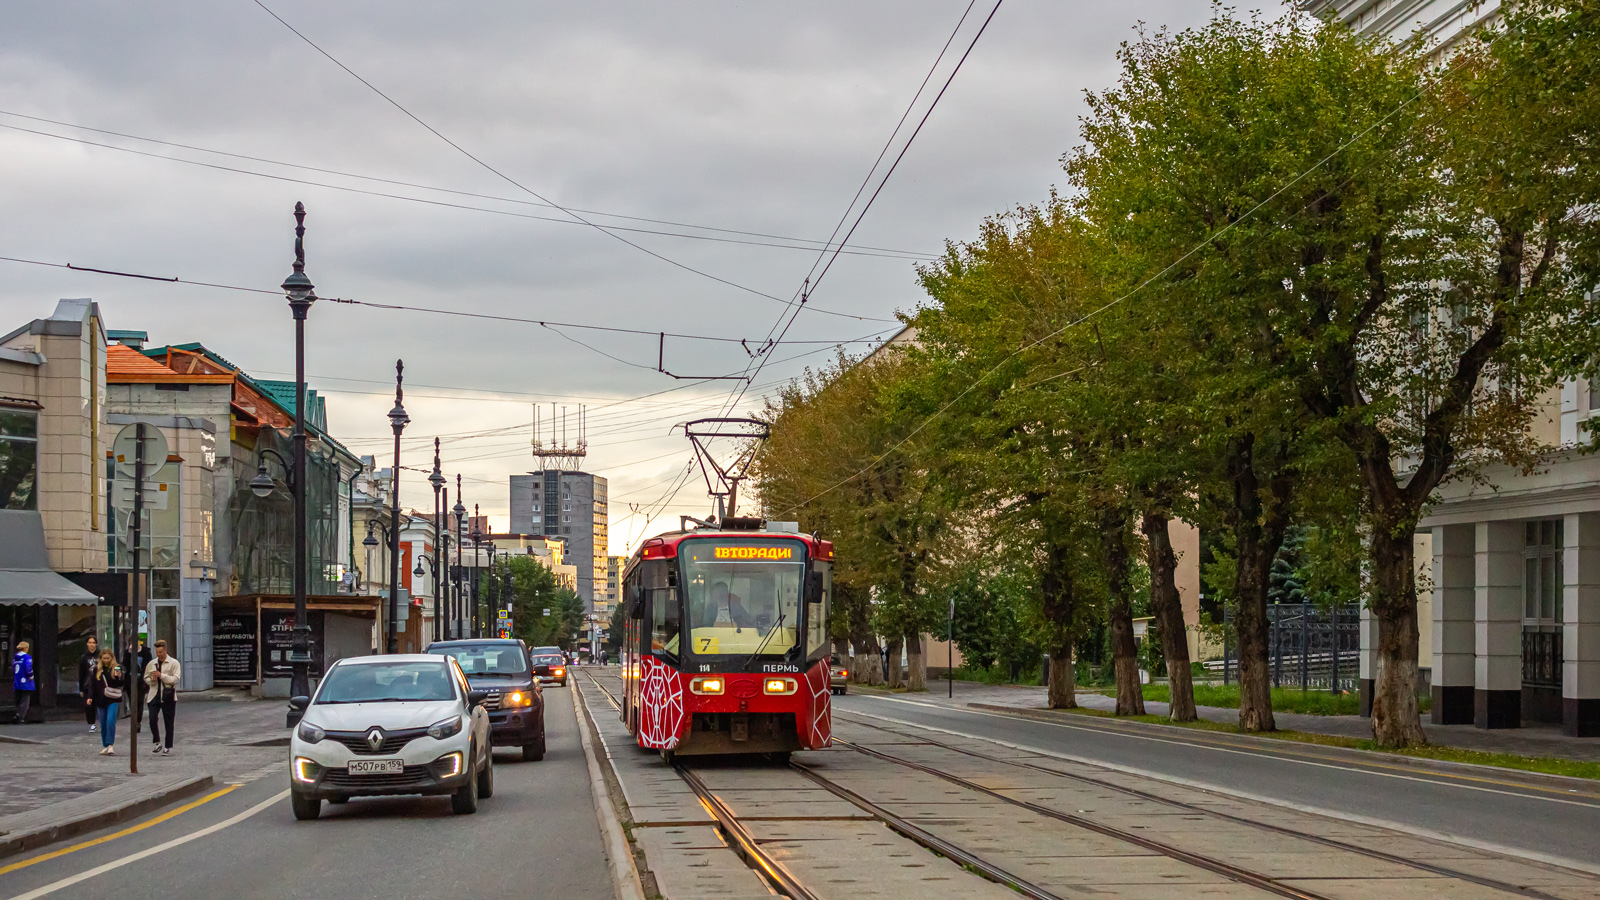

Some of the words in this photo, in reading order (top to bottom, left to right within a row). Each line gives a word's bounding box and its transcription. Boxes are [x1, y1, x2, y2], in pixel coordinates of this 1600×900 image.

[700, 638, 711, 652] 7
[699, 664, 710, 672] 114
[763, 664, 799, 672] ПЕРМЬ
